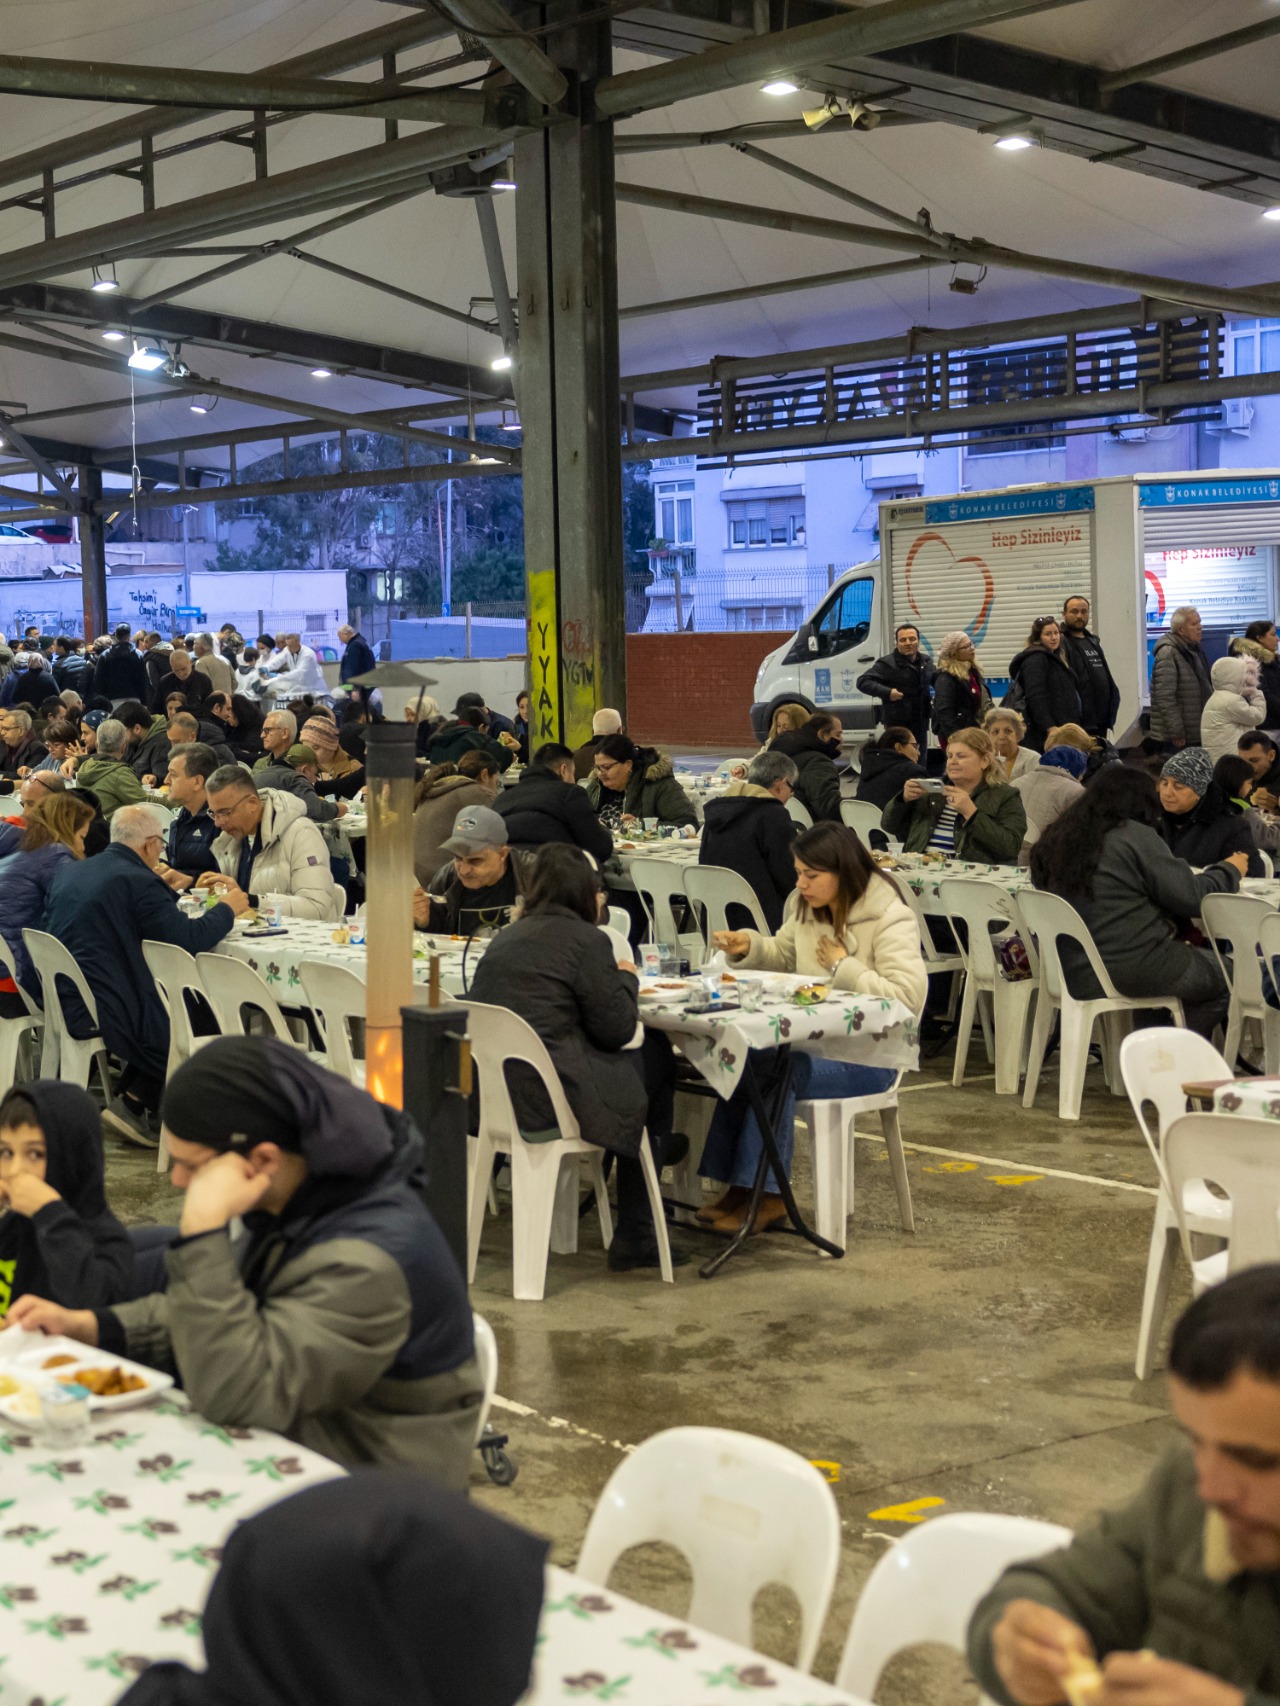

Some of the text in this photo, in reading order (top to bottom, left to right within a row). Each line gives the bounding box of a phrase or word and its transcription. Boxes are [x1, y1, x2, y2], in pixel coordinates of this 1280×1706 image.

[1177, 486, 1267, 498] KONAK BELEDİYESİ
[960, 498, 1053, 514] KONAK BELEDİYESİ
[992, 525, 1082, 549] Hep Sizinleyiz
